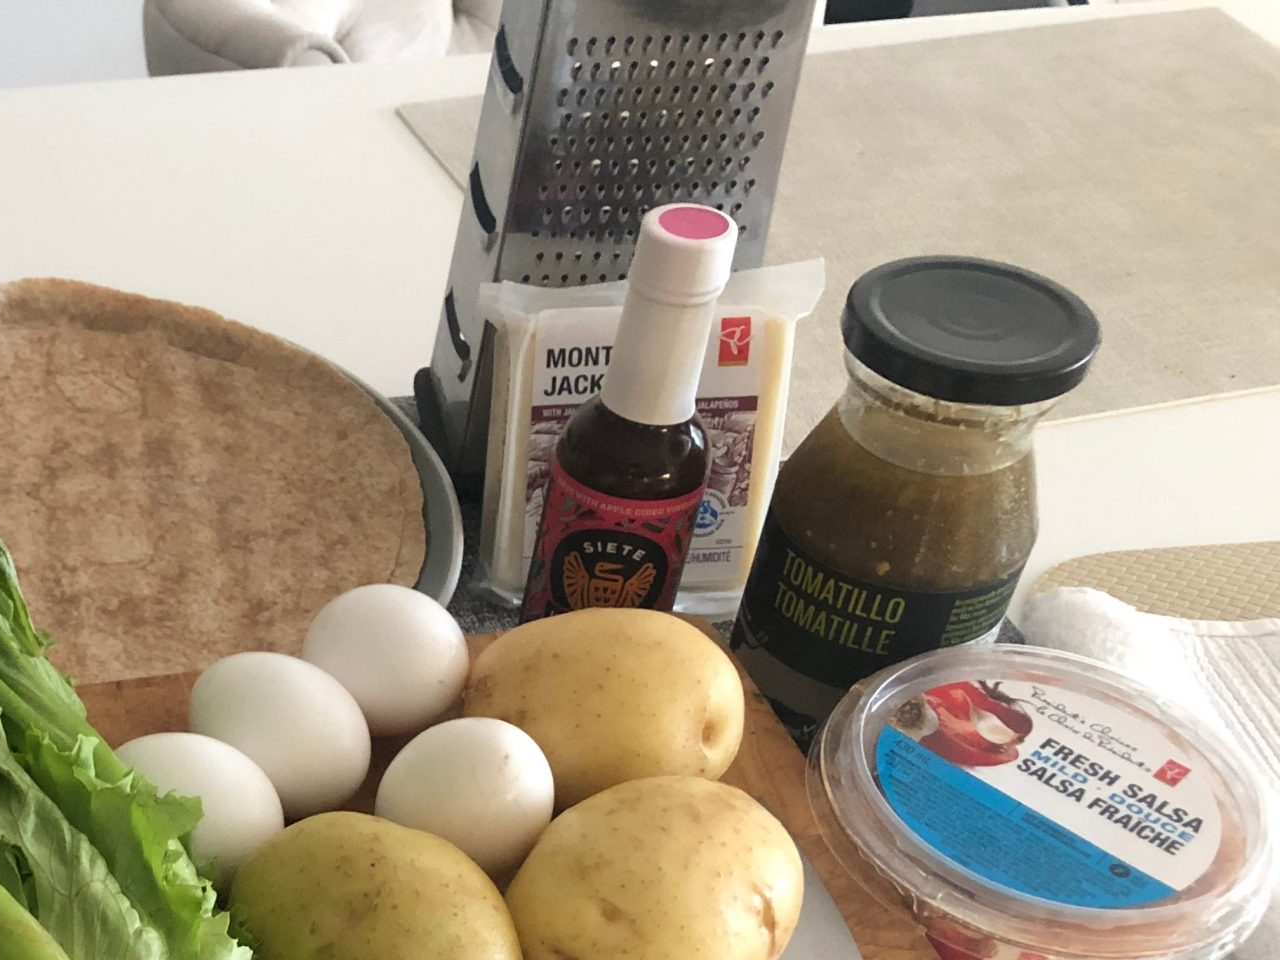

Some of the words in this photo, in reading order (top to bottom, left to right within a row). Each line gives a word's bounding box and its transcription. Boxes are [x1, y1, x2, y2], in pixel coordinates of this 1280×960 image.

[546, 345, 613, 369] MONT
[543, 373, 604, 397] JACK
[600, 502, 632, 516] APPLE
[583, 541, 646, 562] SIETE
[781, 549, 906, 625] TOMATILLO
[773, 581, 896, 655] TOMATILLE
[1016, 758, 1086, 803] SALSA
[1030, 749, 1089, 785] MILD
[1108, 792, 1195, 843] DOUCE
[1039, 737, 1121, 787] FRESH
[1122, 783, 1203, 834] SALSA
